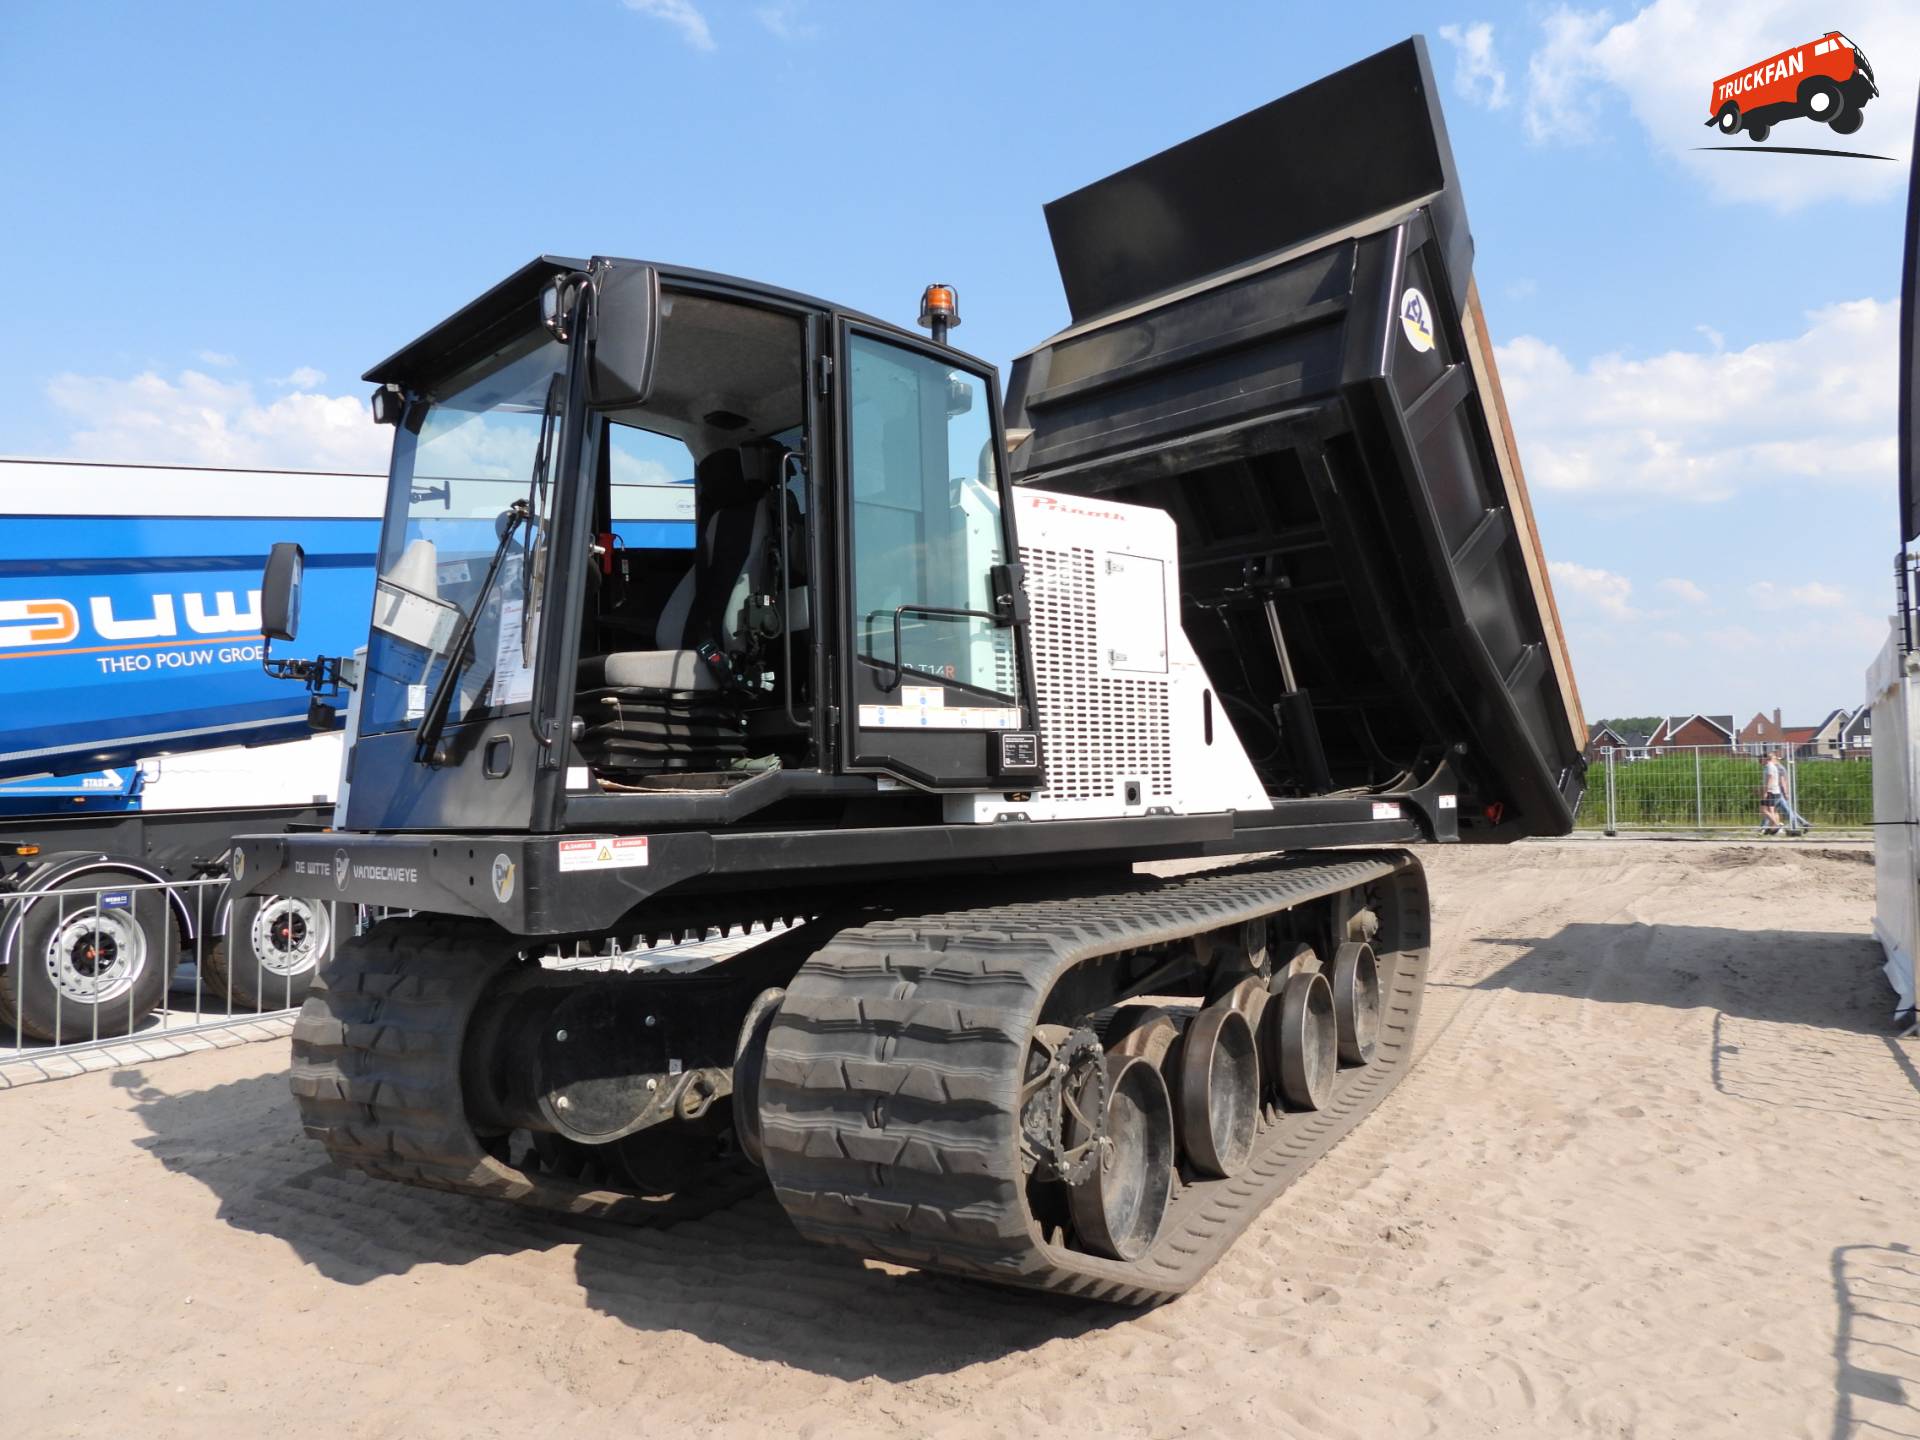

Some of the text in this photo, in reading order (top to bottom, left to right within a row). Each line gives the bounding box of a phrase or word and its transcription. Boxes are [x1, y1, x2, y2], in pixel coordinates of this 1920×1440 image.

[97, 655, 151, 674] THEO
[156, 650, 214, 669] POUW
[295, 861, 418, 883] DE WITTE VANDECAVEYE
